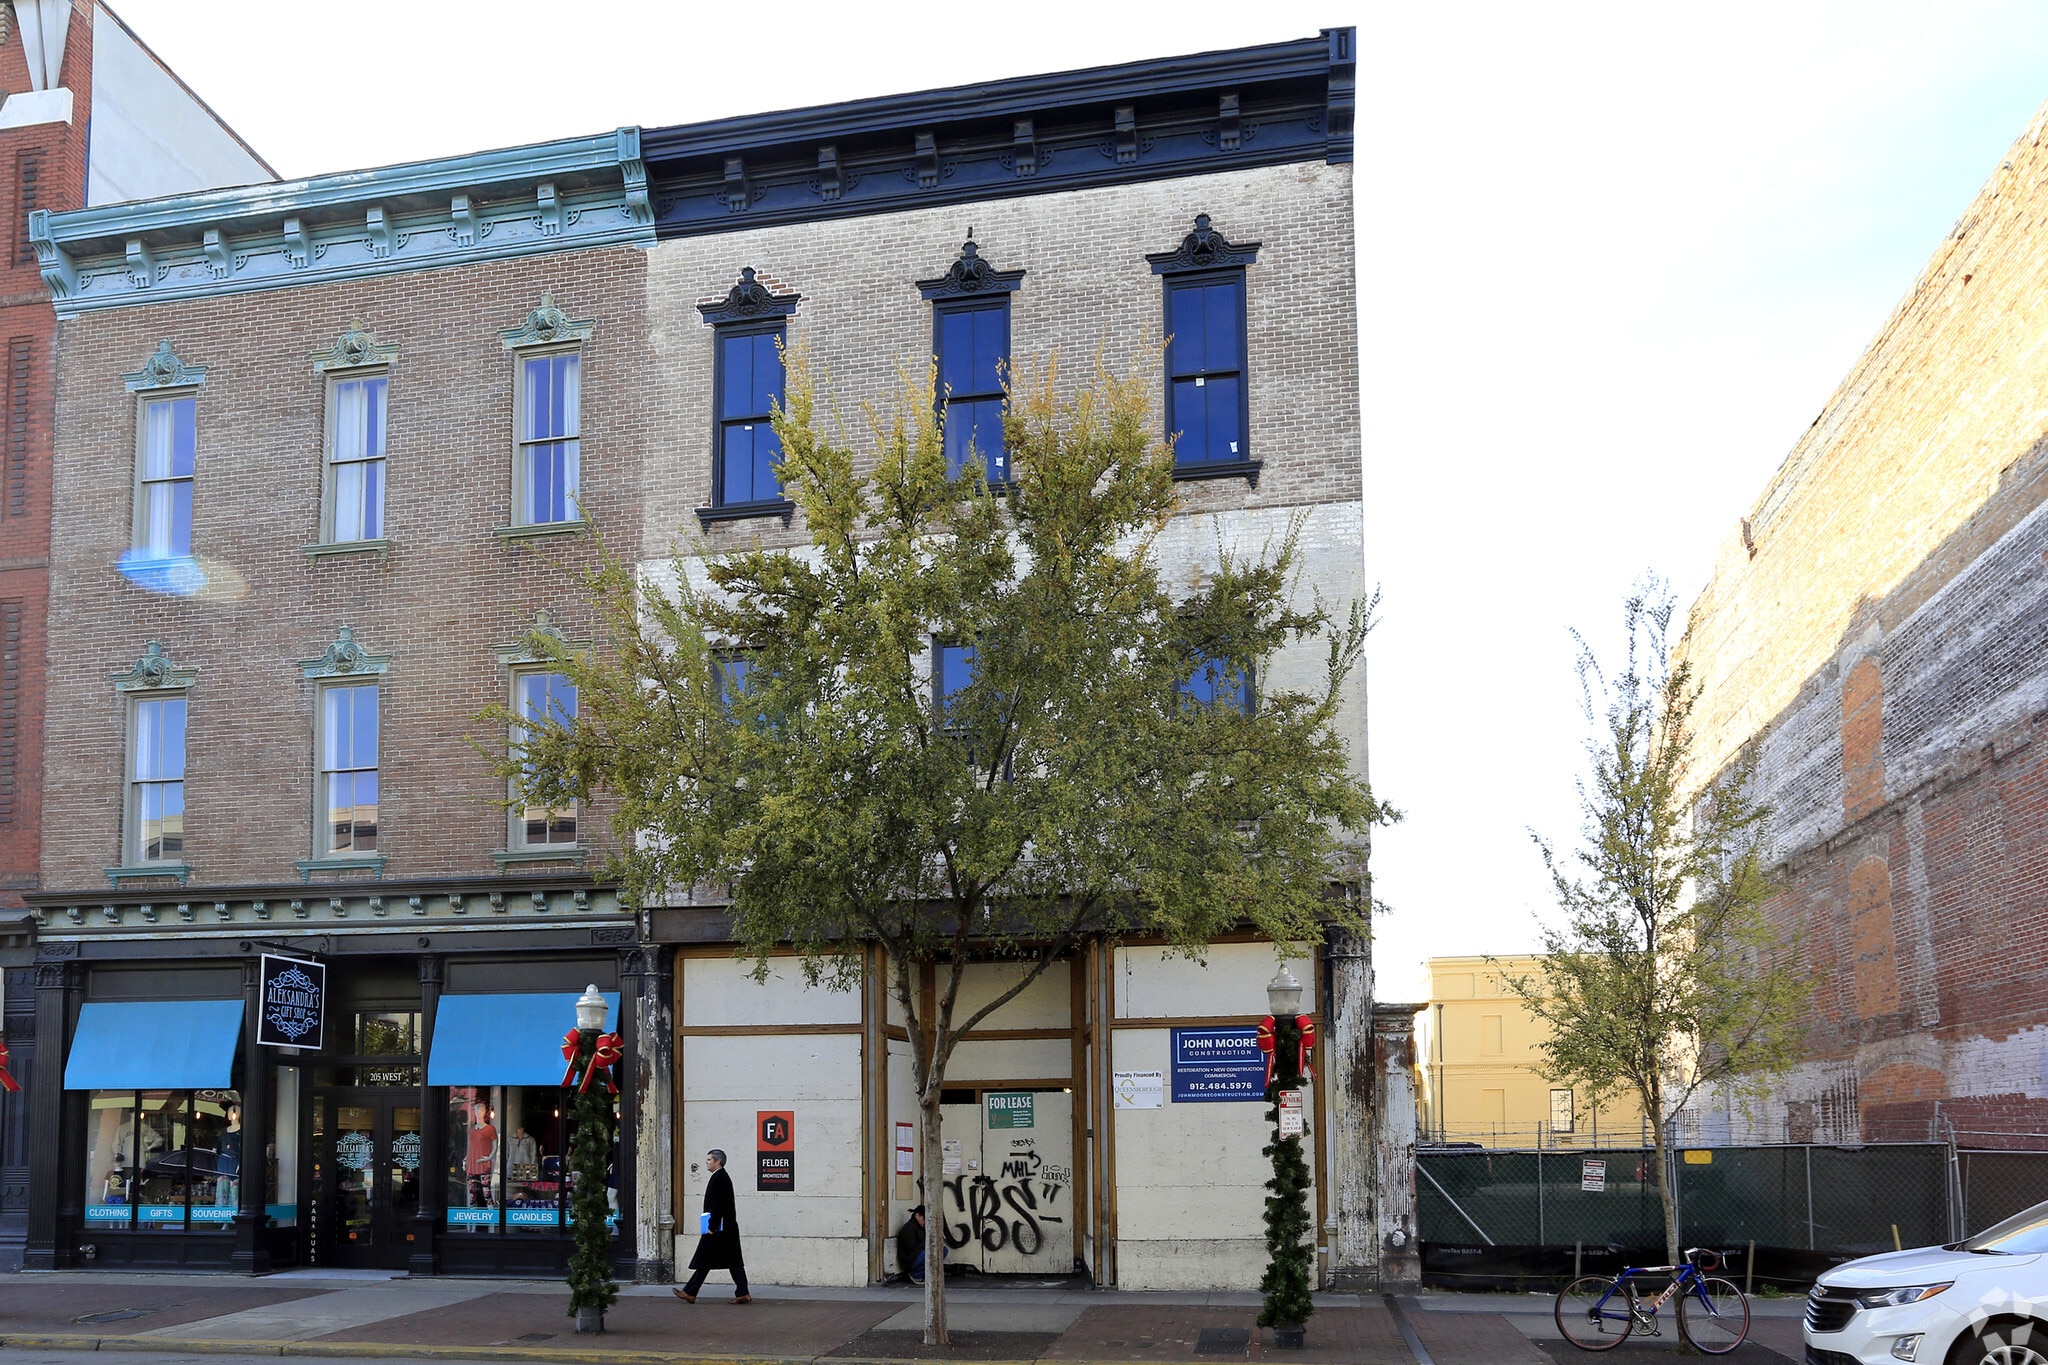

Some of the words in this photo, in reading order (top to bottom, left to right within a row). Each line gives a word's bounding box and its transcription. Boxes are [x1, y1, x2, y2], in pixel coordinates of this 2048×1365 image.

[267, 987, 320, 1009] ALEKSANDRA'S
[280, 1005, 293, 1018] GIFT
[293, 1007, 306, 1020] SHOP
[1183, 1039, 1213, 1049] JOHN
[1215, 1037, 1257, 1048] MOORE
[370, 1072, 381, 1081] 205
[382, 1072, 402, 1081] WEST
[1189, 1082, 1252, 1090] 912.484.5976
[989, 1098, 1006, 1110] FOR
[1007, 1097, 1032, 1109] LEASE
[767, 1123, 785, 1139] FA
[762, 1159, 789, 1167] FELDER
[89, 1208, 129, 1217] CLOTHING
[150, 1209, 173, 1218] GIFTS
[192, 1209, 237, 1218] SOUVENIRS
[453, 1212, 494, 1221] JEWELRY
[512, 1212, 553, 1222] CANDLES
